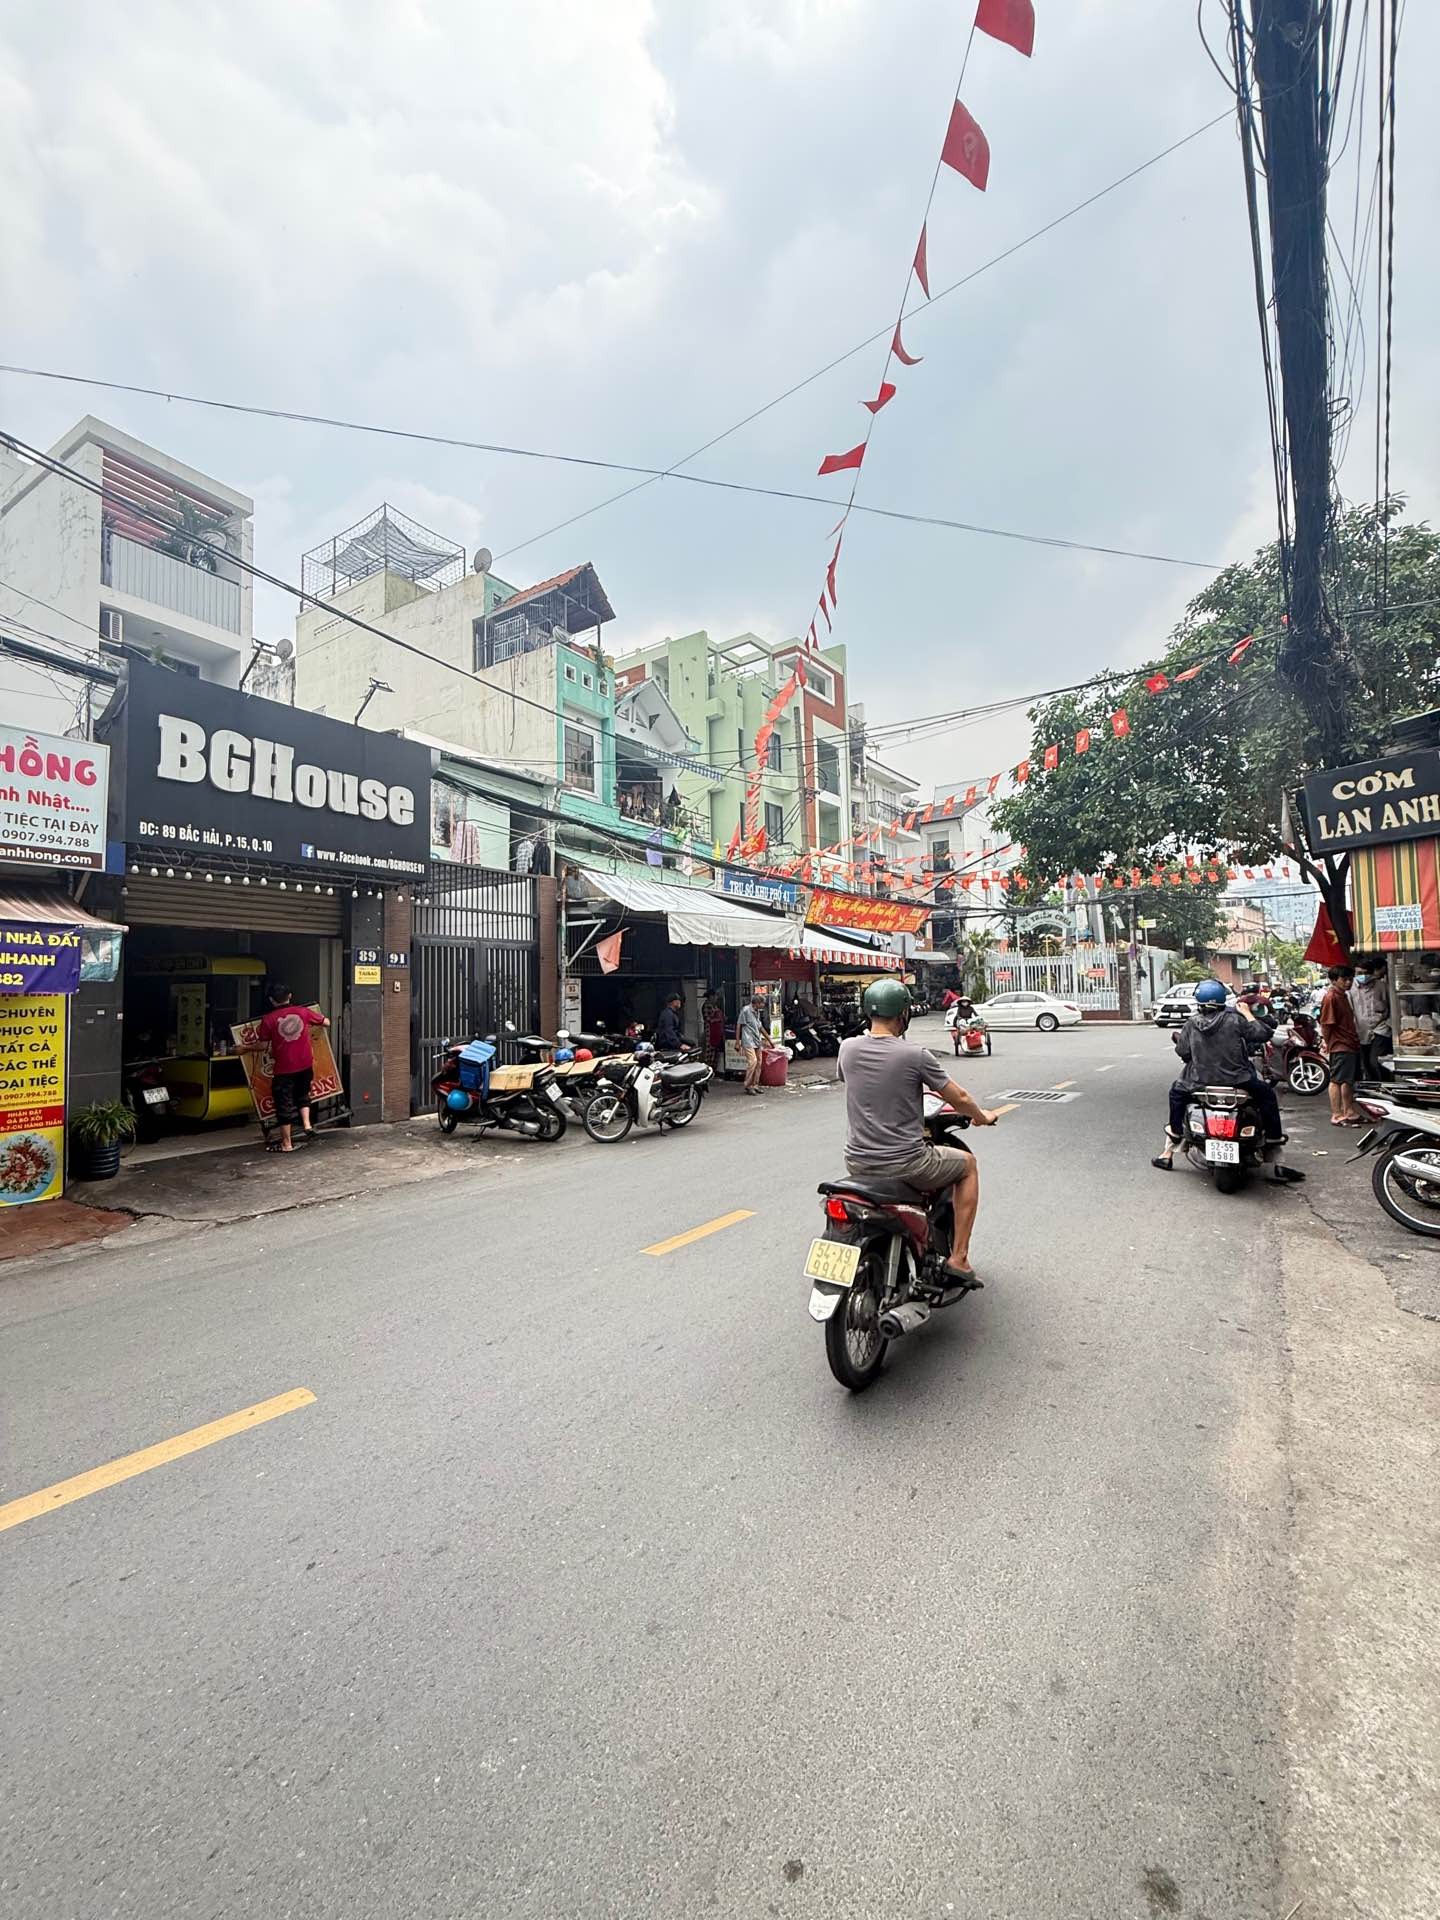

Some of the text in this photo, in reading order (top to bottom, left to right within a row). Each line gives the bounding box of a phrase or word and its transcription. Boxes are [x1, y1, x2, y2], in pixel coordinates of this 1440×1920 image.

[157, 713, 415, 826] BGHouse
[1332, 768, 1416, 800] CƠM
[4, 811, 99, 835] TIỆC TẠI ĐÂY
[1317, 794, 1440, 840] LAN ANH
[2, 829, 90, 848] 0907.994.788
[139, 821, 159, 836] ĐC:
[162, 824, 176, 838] 89
[179, 823, 200, 843] BẮC
[203, 828, 223, 847] HẢI,
[755, 885, 769, 899] KHU
[6, 930, 80, 947] NHÀ ĐẤT
[359, 950, 377, 962] 89
[390, 953, 405, 964] 91
[39, 1024, 57, 1037] VỤ
[0, 1039, 51, 1054] TẤT CẢ
[32, 1054, 57, 1069] THỂ
[29, 1074, 59, 1088] TIỆC
